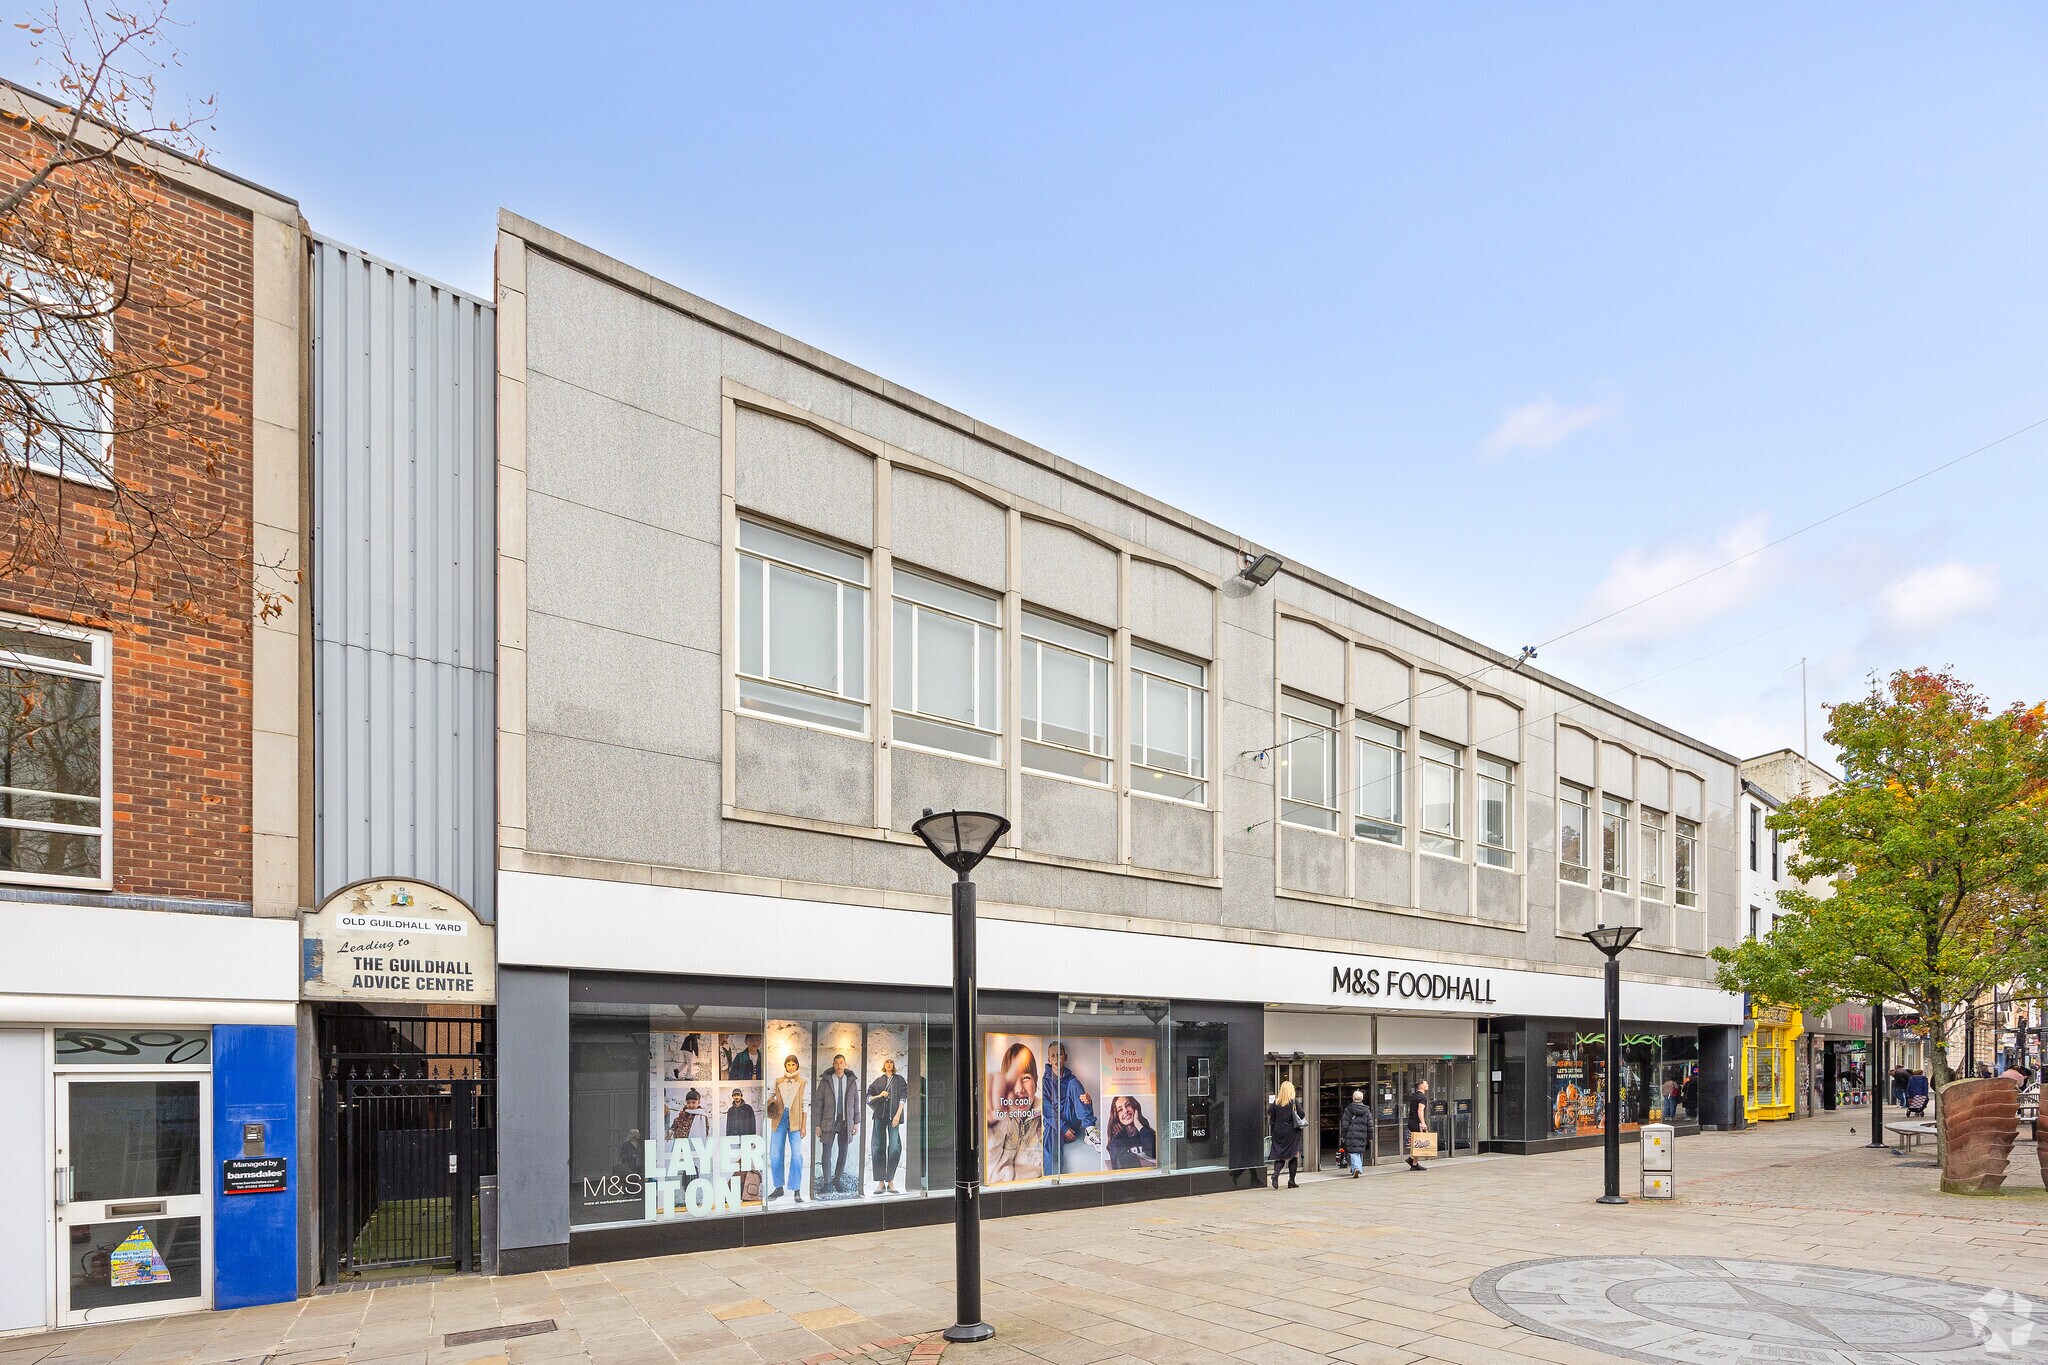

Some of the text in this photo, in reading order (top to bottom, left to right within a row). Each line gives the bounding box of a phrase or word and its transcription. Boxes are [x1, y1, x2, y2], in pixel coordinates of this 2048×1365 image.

[342, 917, 462, 932] OLD GUILDHALL YARD
[337, 938, 410, 954] Leading to
[353, 956, 473, 975] THE GUILDHALL
[352, 974, 474, 992] ADVICE CENTRE
[1332, 966, 1497, 1004] M&S FOODHALL
[999, 1097, 1032, 1106] Too cool
[996, 1108, 1035, 1118] for school
[1192, 1129, 1205, 1137] M&S
[645, 1134, 767, 1177] LAYER
[227, 1170, 283, 1179] barnsdales
[583, 1173, 643, 1198] M&S
[645, 1175, 741, 1220] IT ON
